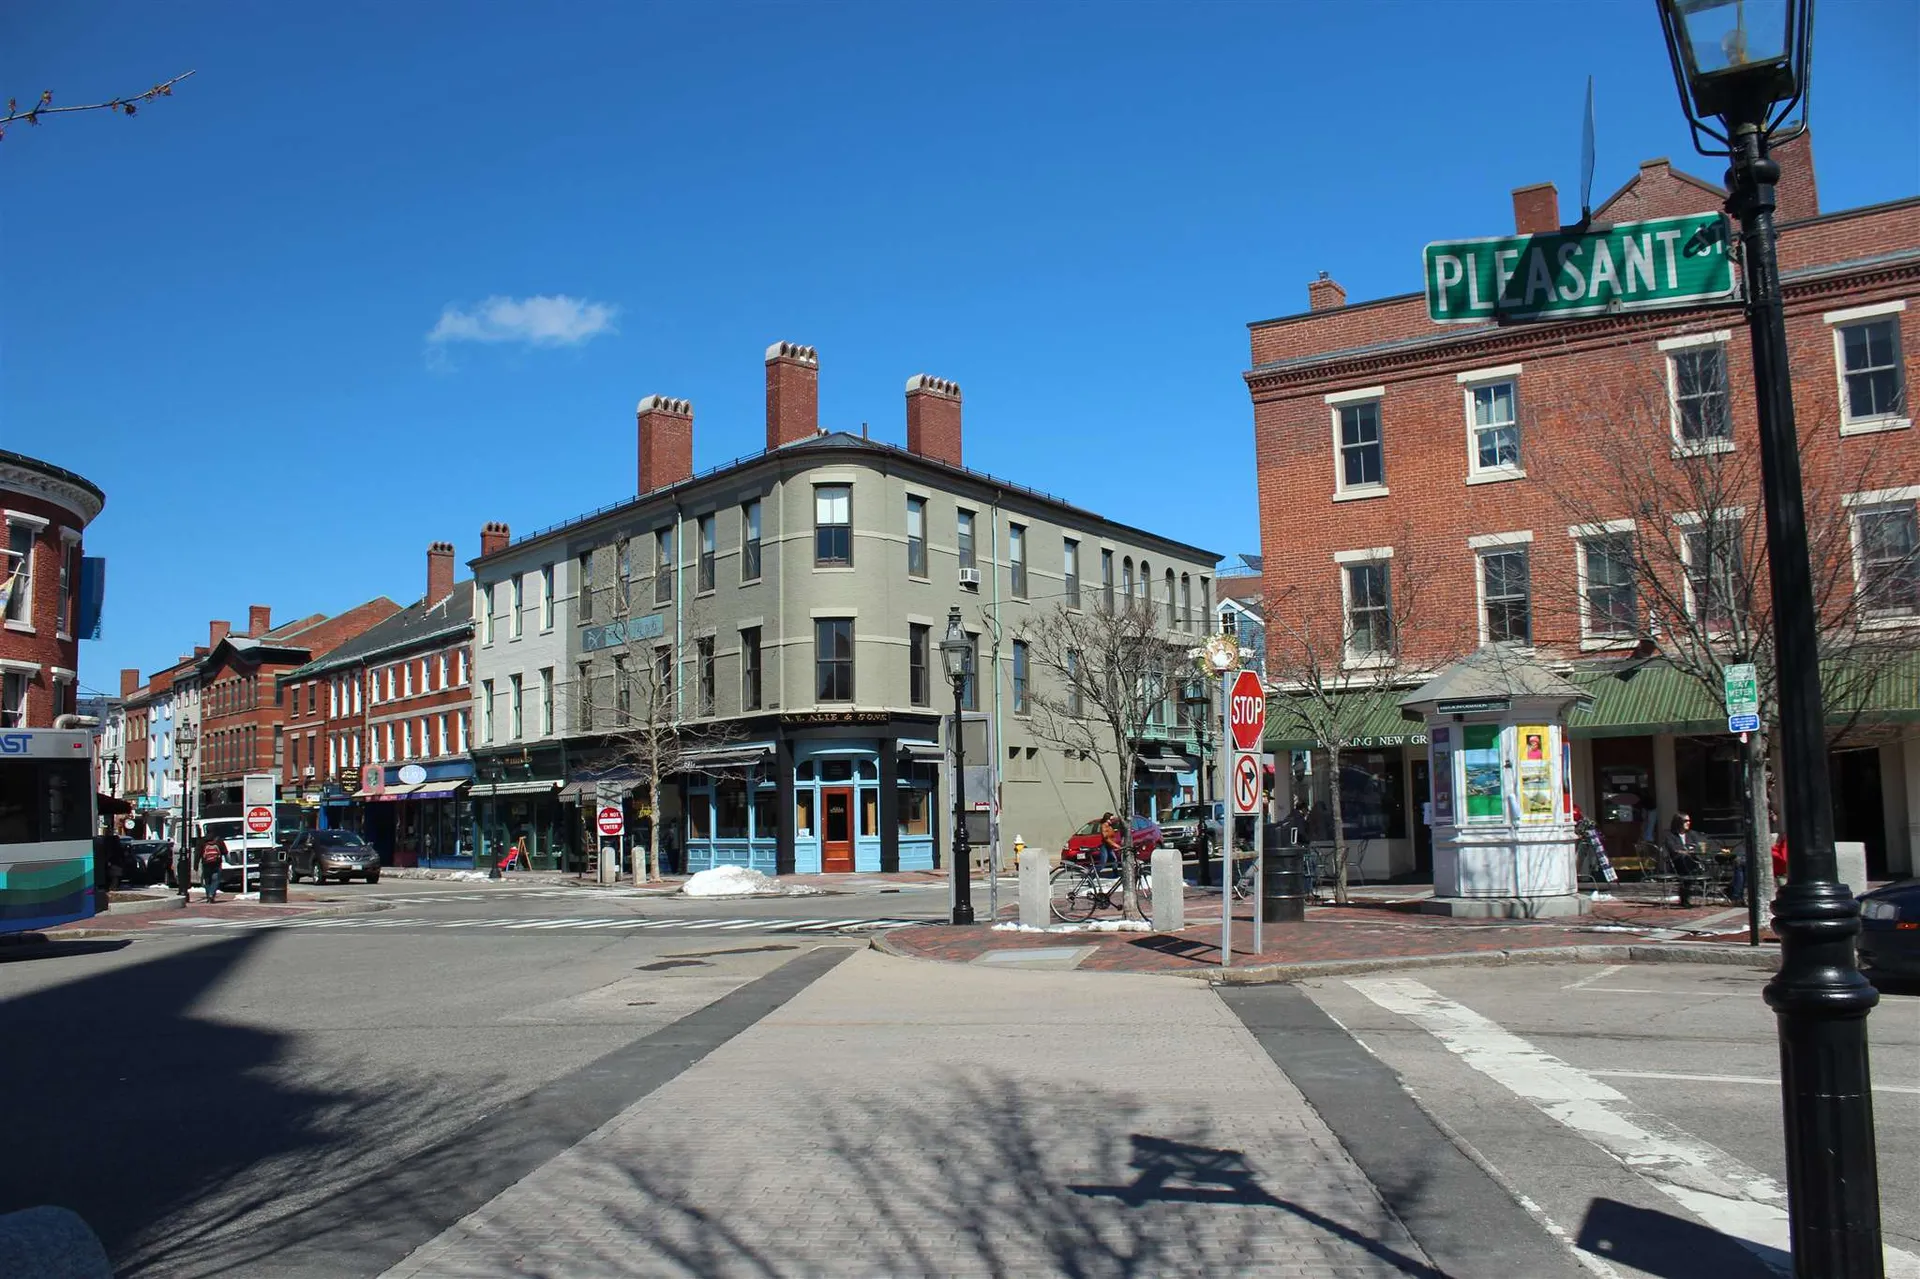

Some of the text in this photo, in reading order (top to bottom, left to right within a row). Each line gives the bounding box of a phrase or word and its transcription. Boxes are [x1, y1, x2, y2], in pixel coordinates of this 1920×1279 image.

[1435, 229, 1681, 312] PLEASANT
[1728, 687, 1753, 697] METER
[1232, 695, 1263, 725] STOP
[808, 713, 838, 721] ALIE
[844, 713, 853, 721] &
[1379, 735, 1405, 746] NEW
